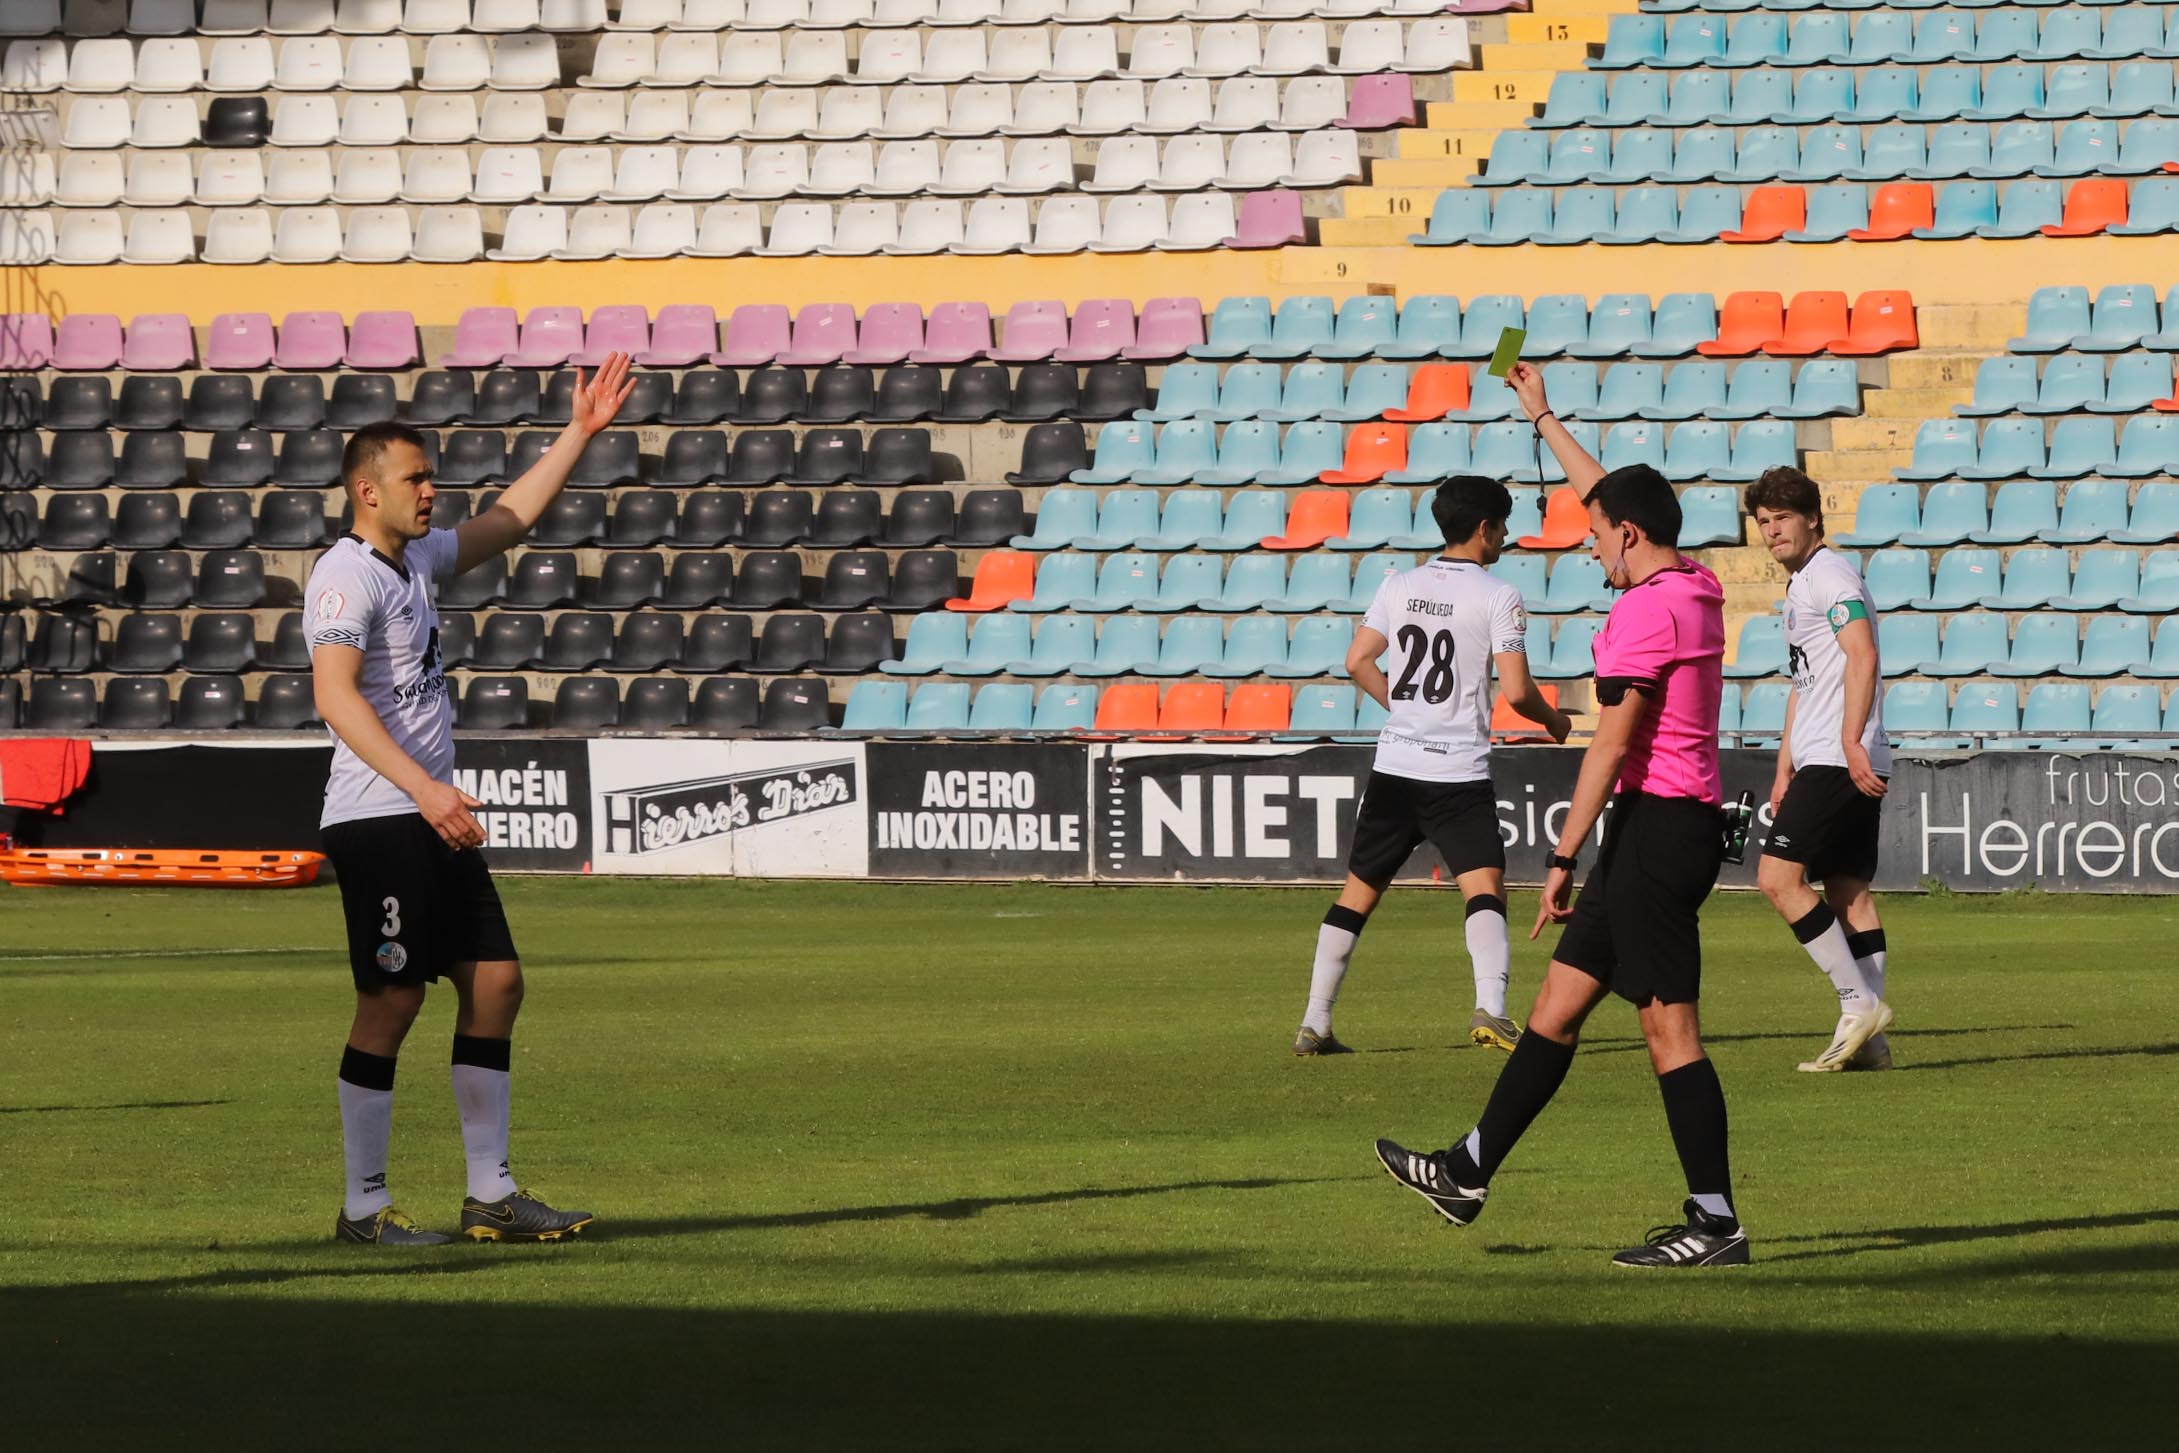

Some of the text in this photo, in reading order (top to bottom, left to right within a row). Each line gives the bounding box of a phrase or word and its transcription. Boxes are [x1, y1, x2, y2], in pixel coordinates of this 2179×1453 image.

[1547, 25, 1568, 40] 13
[1495, 84, 1516, 100] 12
[1444, 138, 1461, 154] 11
[1388, 197, 1411, 214] 10
[1337, 262, 1347, 277] 9
[1942, 366, 1953, 382] 8
[1887, 430, 1897, 447] 7
[1827, 495, 1837, 511] 6
[1391, 624, 1455, 704] 28
[921, 770, 1036, 810] ACERO
[1141, 774, 1364, 859] NIET
[470, 812, 578, 849] IERRO
[877, 811, 1081, 852] INOXIDABLE
[381, 896, 401, 937] 3
